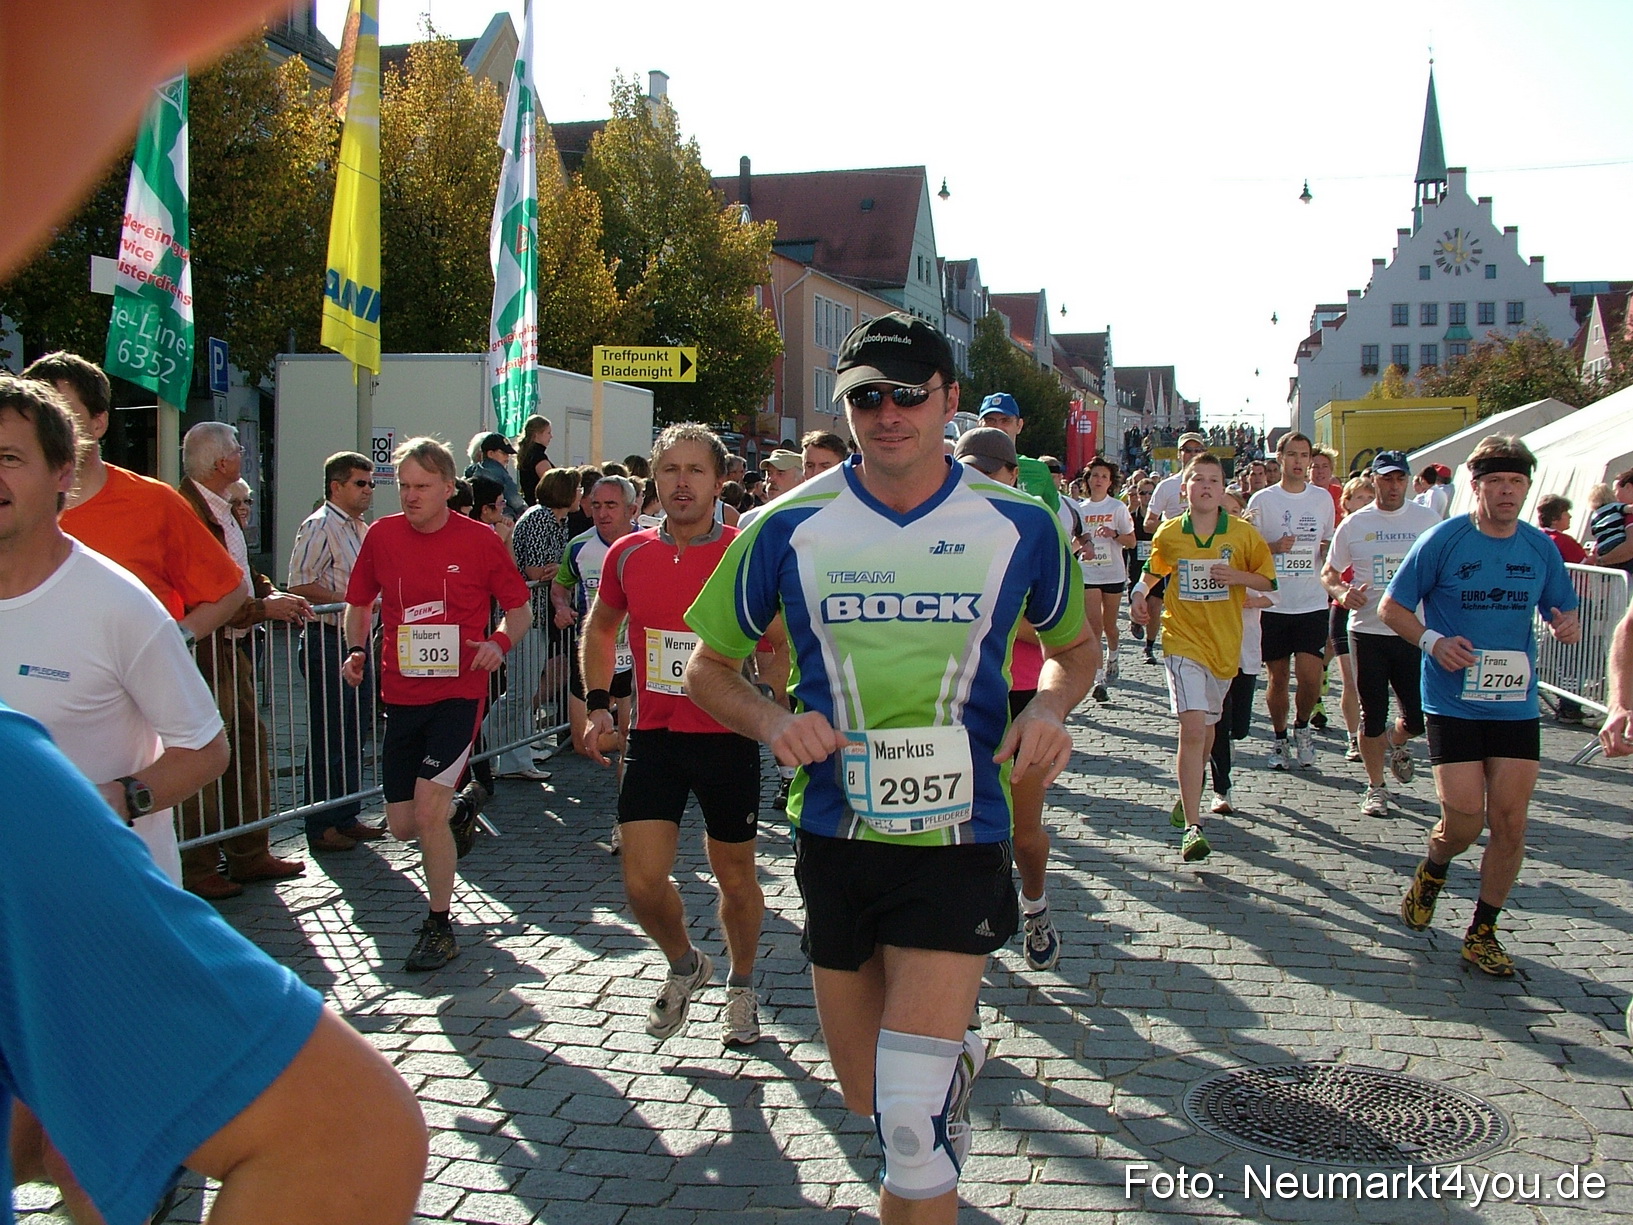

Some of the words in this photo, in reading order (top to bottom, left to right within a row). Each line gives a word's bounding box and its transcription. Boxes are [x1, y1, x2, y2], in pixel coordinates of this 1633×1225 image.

[117, 339, 177, 384] 6352
[601, 349, 668, 363] Treffpunkt
[214, 346, 224, 384] P
[601, 365, 673, 379] Bladenight
[1286, 559, 1312, 569] 2692
[827, 571, 895, 583] TEAM
[1461, 590, 1486, 602] EURO
[1507, 591, 1529, 602] PLUS
[821, 592, 982, 624] BOCK
[412, 630, 441, 640] Hubert
[419, 648, 450, 662] 303
[1484, 655, 1508, 666] Franz
[1483, 674, 1524, 687] 2704
[874, 738, 935, 760] Markus
[848, 770, 856, 785] B
[879, 772, 962, 806] 2957
[924, 808, 970, 826] PFLEIDERER
